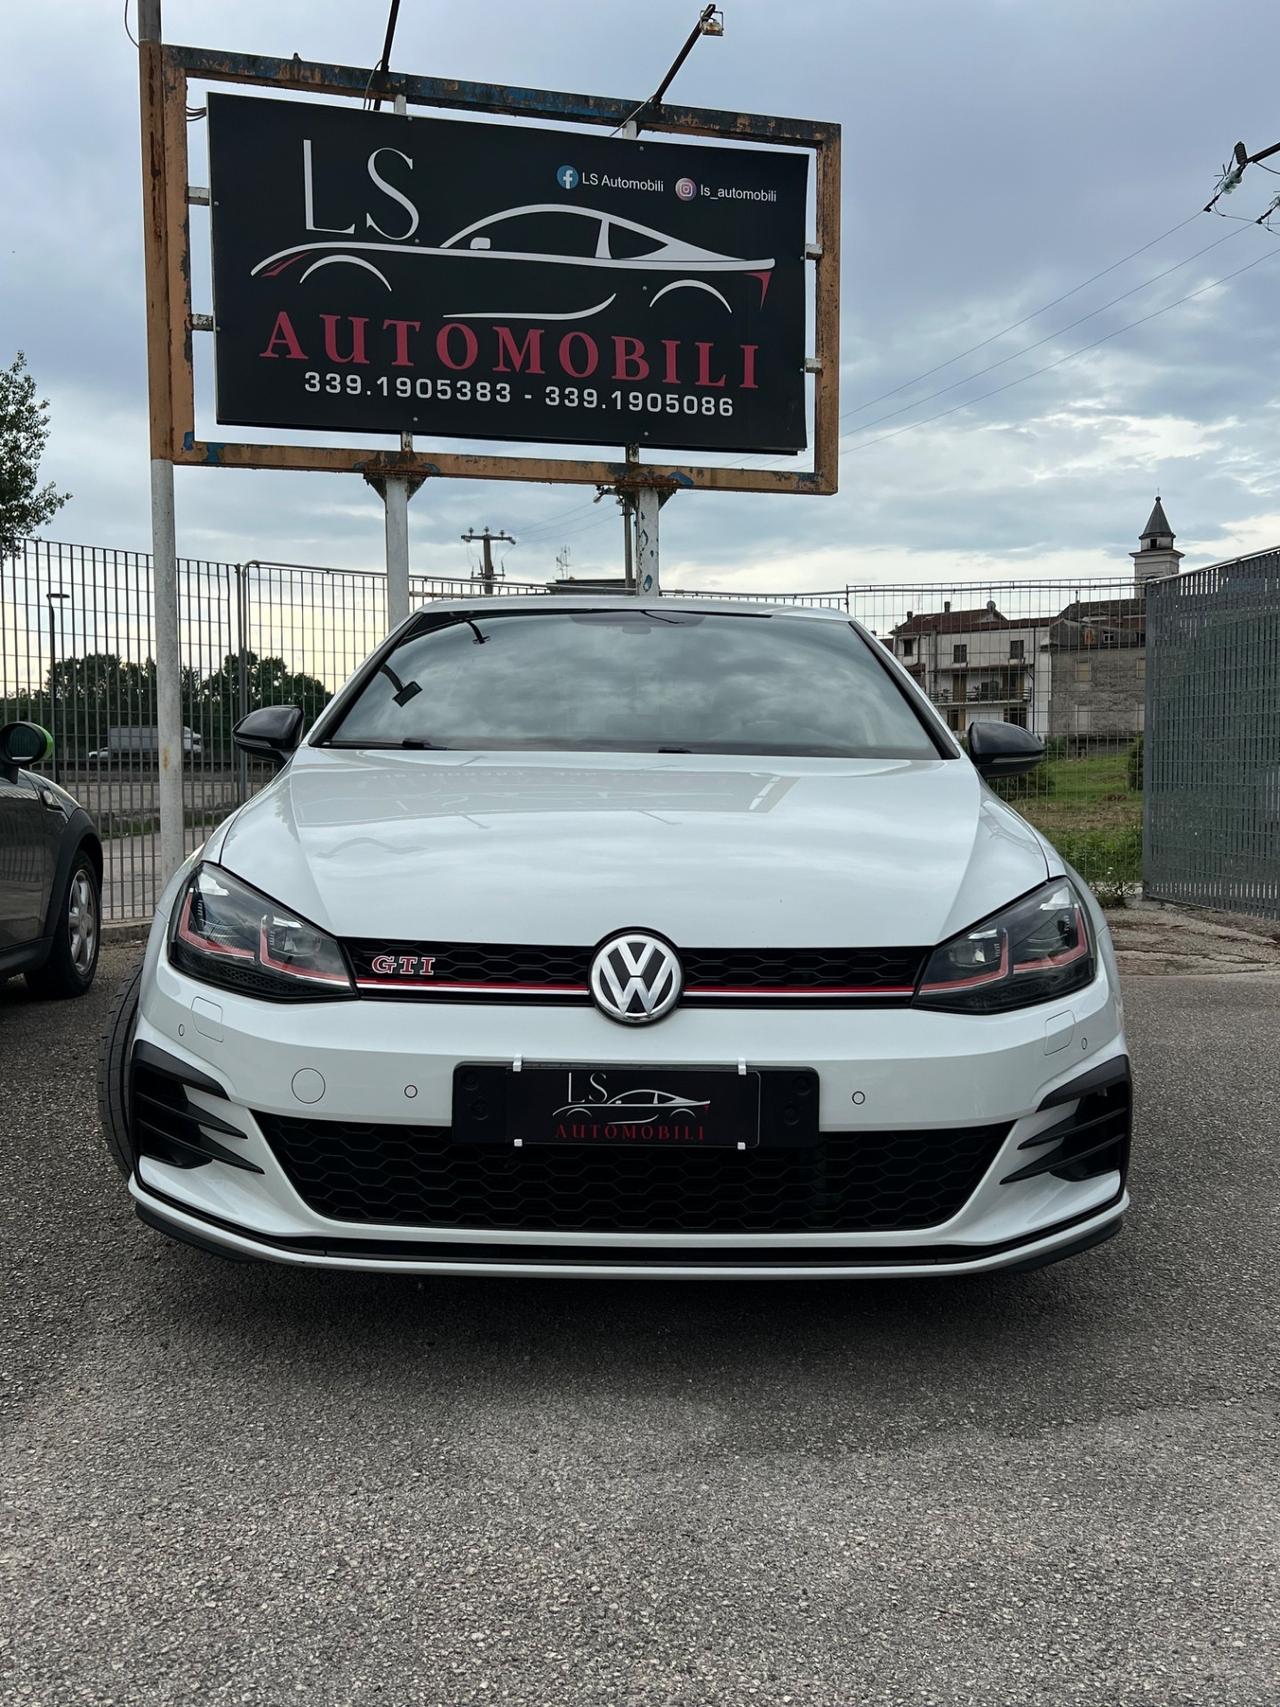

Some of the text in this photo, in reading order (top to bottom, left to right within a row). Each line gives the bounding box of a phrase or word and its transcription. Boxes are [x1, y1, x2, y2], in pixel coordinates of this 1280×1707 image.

[302, 138, 420, 241] LS
[582, 172, 664, 193] LS Automobili
[700, 184, 777, 203] ls_automobili
[260, 310, 760, 389] AUTOMOBILI
[304, 371, 512, 403] 339.1905383
[544, 386, 734, 417] 339.1905086
[371, 955, 436, 976] GTI
[568, 1072, 608, 1104] LS
[555, 1124, 705, 1141] AUTOMOBILI
